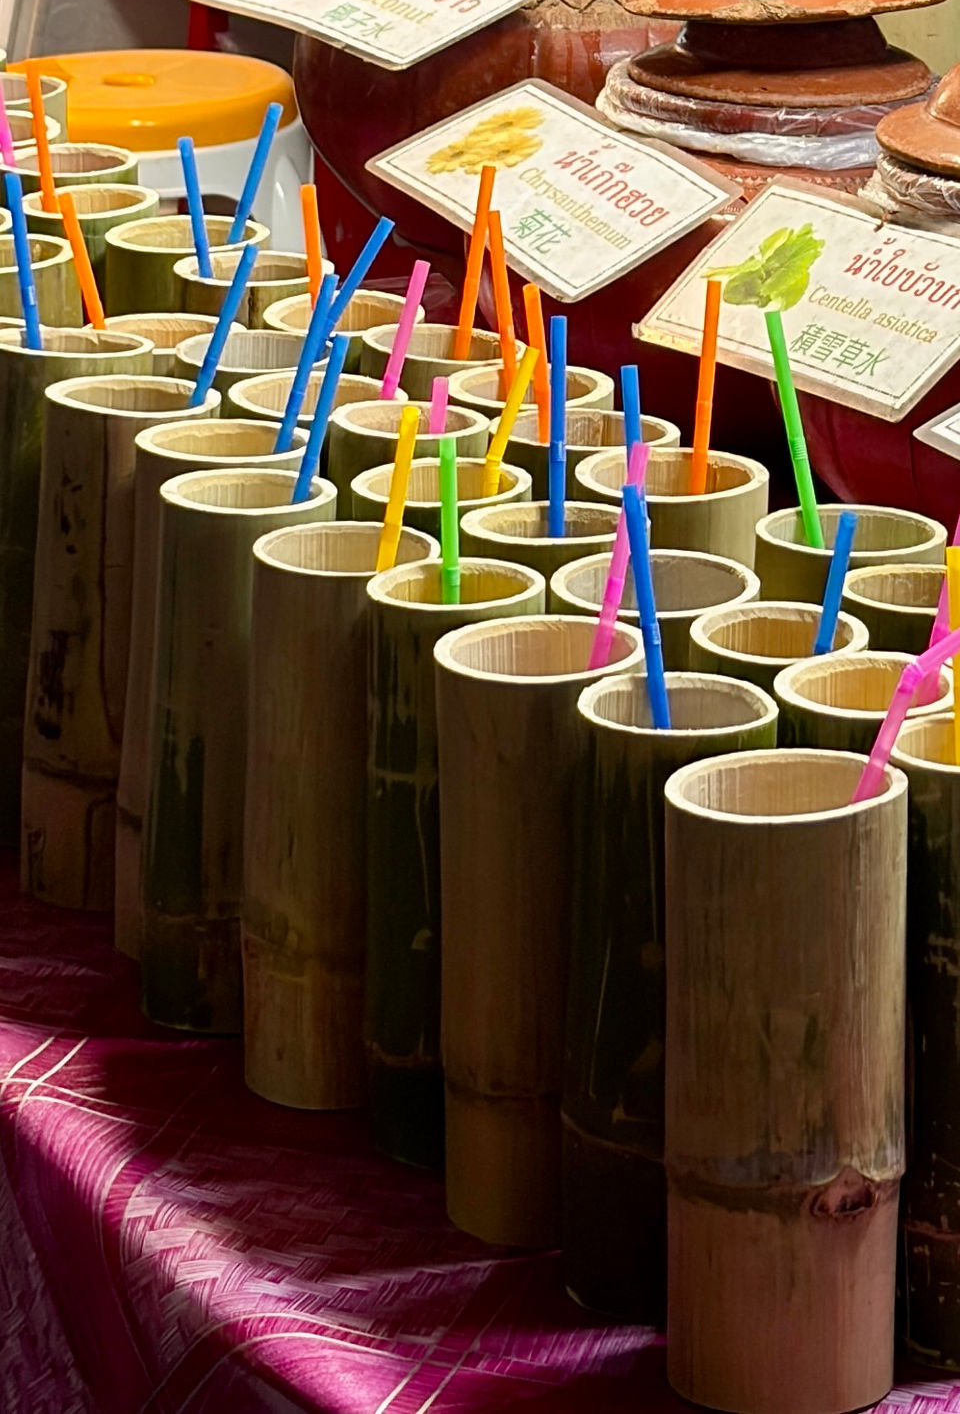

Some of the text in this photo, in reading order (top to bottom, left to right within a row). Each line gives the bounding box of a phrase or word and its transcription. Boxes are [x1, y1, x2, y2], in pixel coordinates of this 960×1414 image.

[518, 166, 632, 251] Chrysanthemum
[554, 143, 670, 227] น้ำเก๊กฮวย
[509, 208, 572, 254] 菊花
[807, 285, 939, 345] Centella asiatica
[789, 323, 890, 376] 積雪草水
